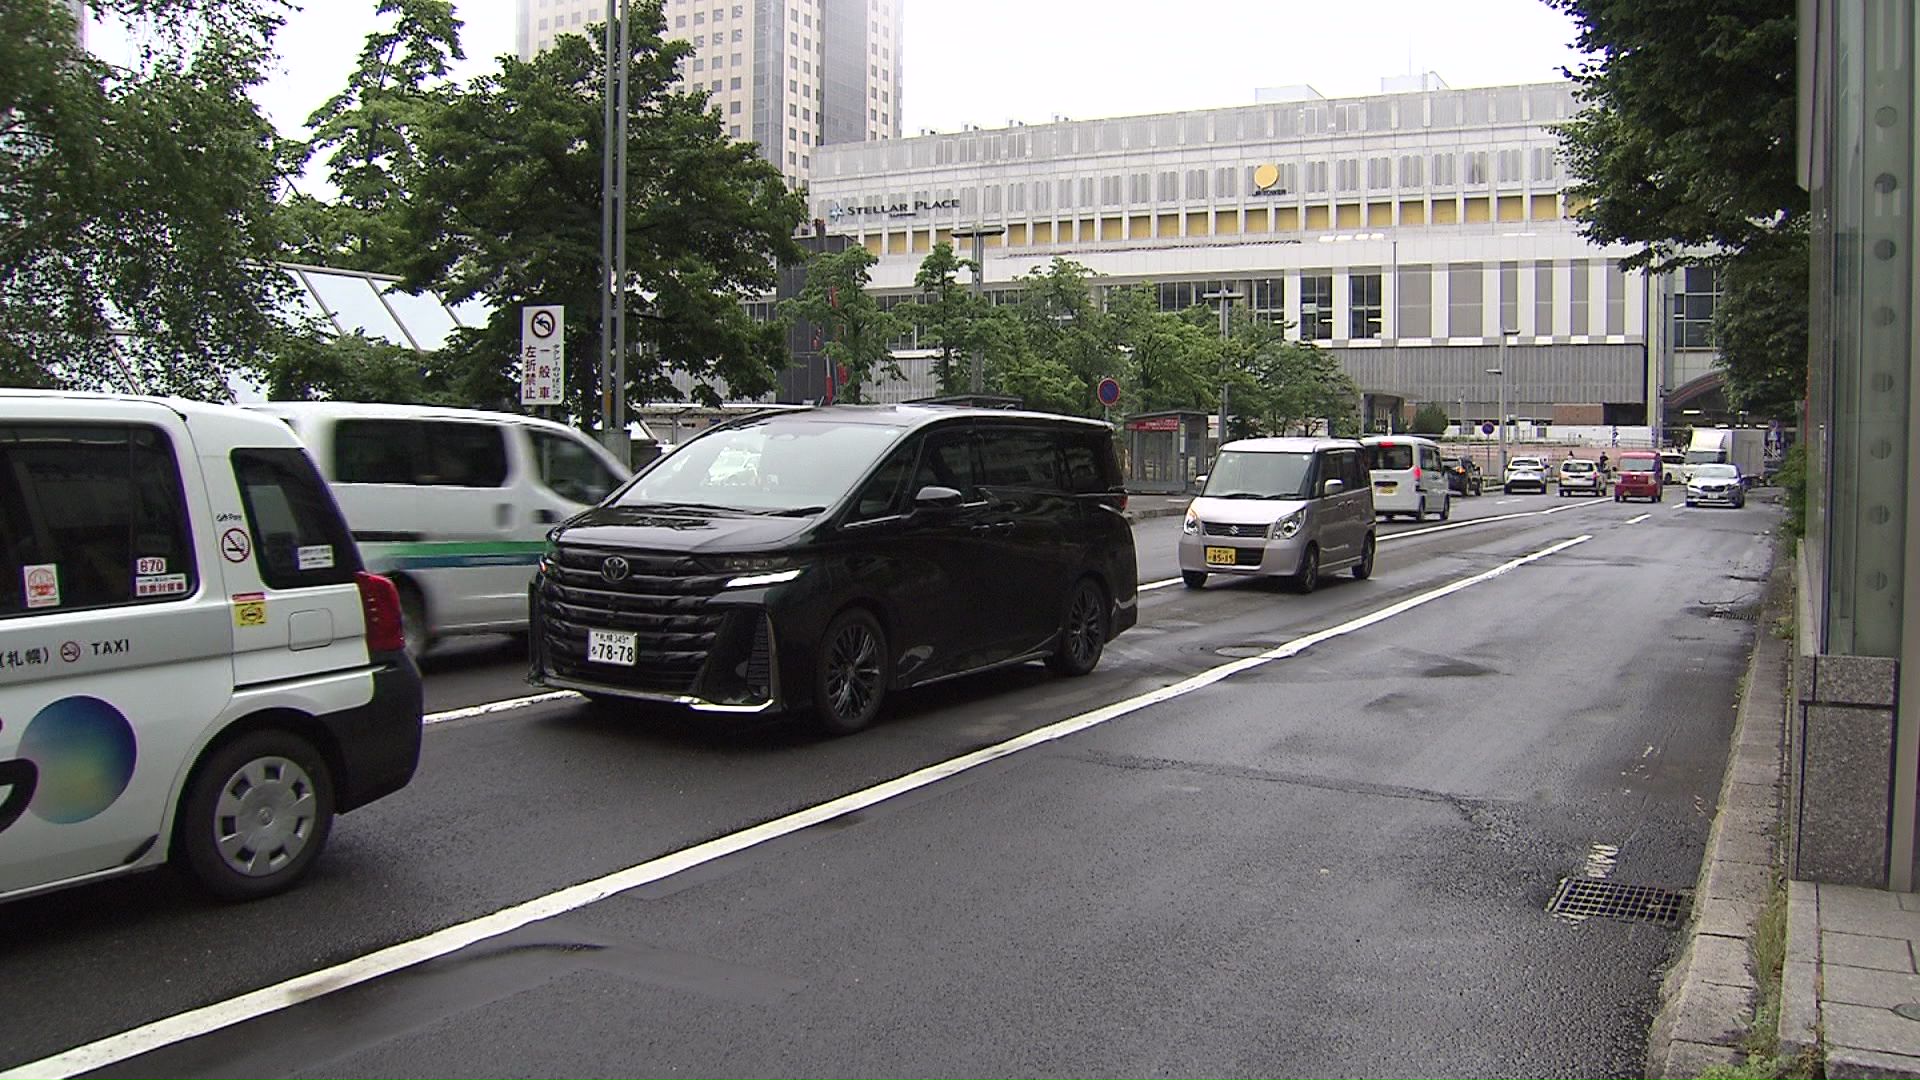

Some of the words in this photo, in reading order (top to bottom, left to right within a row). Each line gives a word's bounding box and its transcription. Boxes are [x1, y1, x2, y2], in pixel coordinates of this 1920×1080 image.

[847, 203, 908, 216] STELLAR
[914, 199, 960, 210] PLACE
[524, 344, 537, 399] 左折禁止
[539, 348, 551, 399] 一般車
[90, 638, 129, 656] TAXI
[598, 642, 633, 663] 78-78
